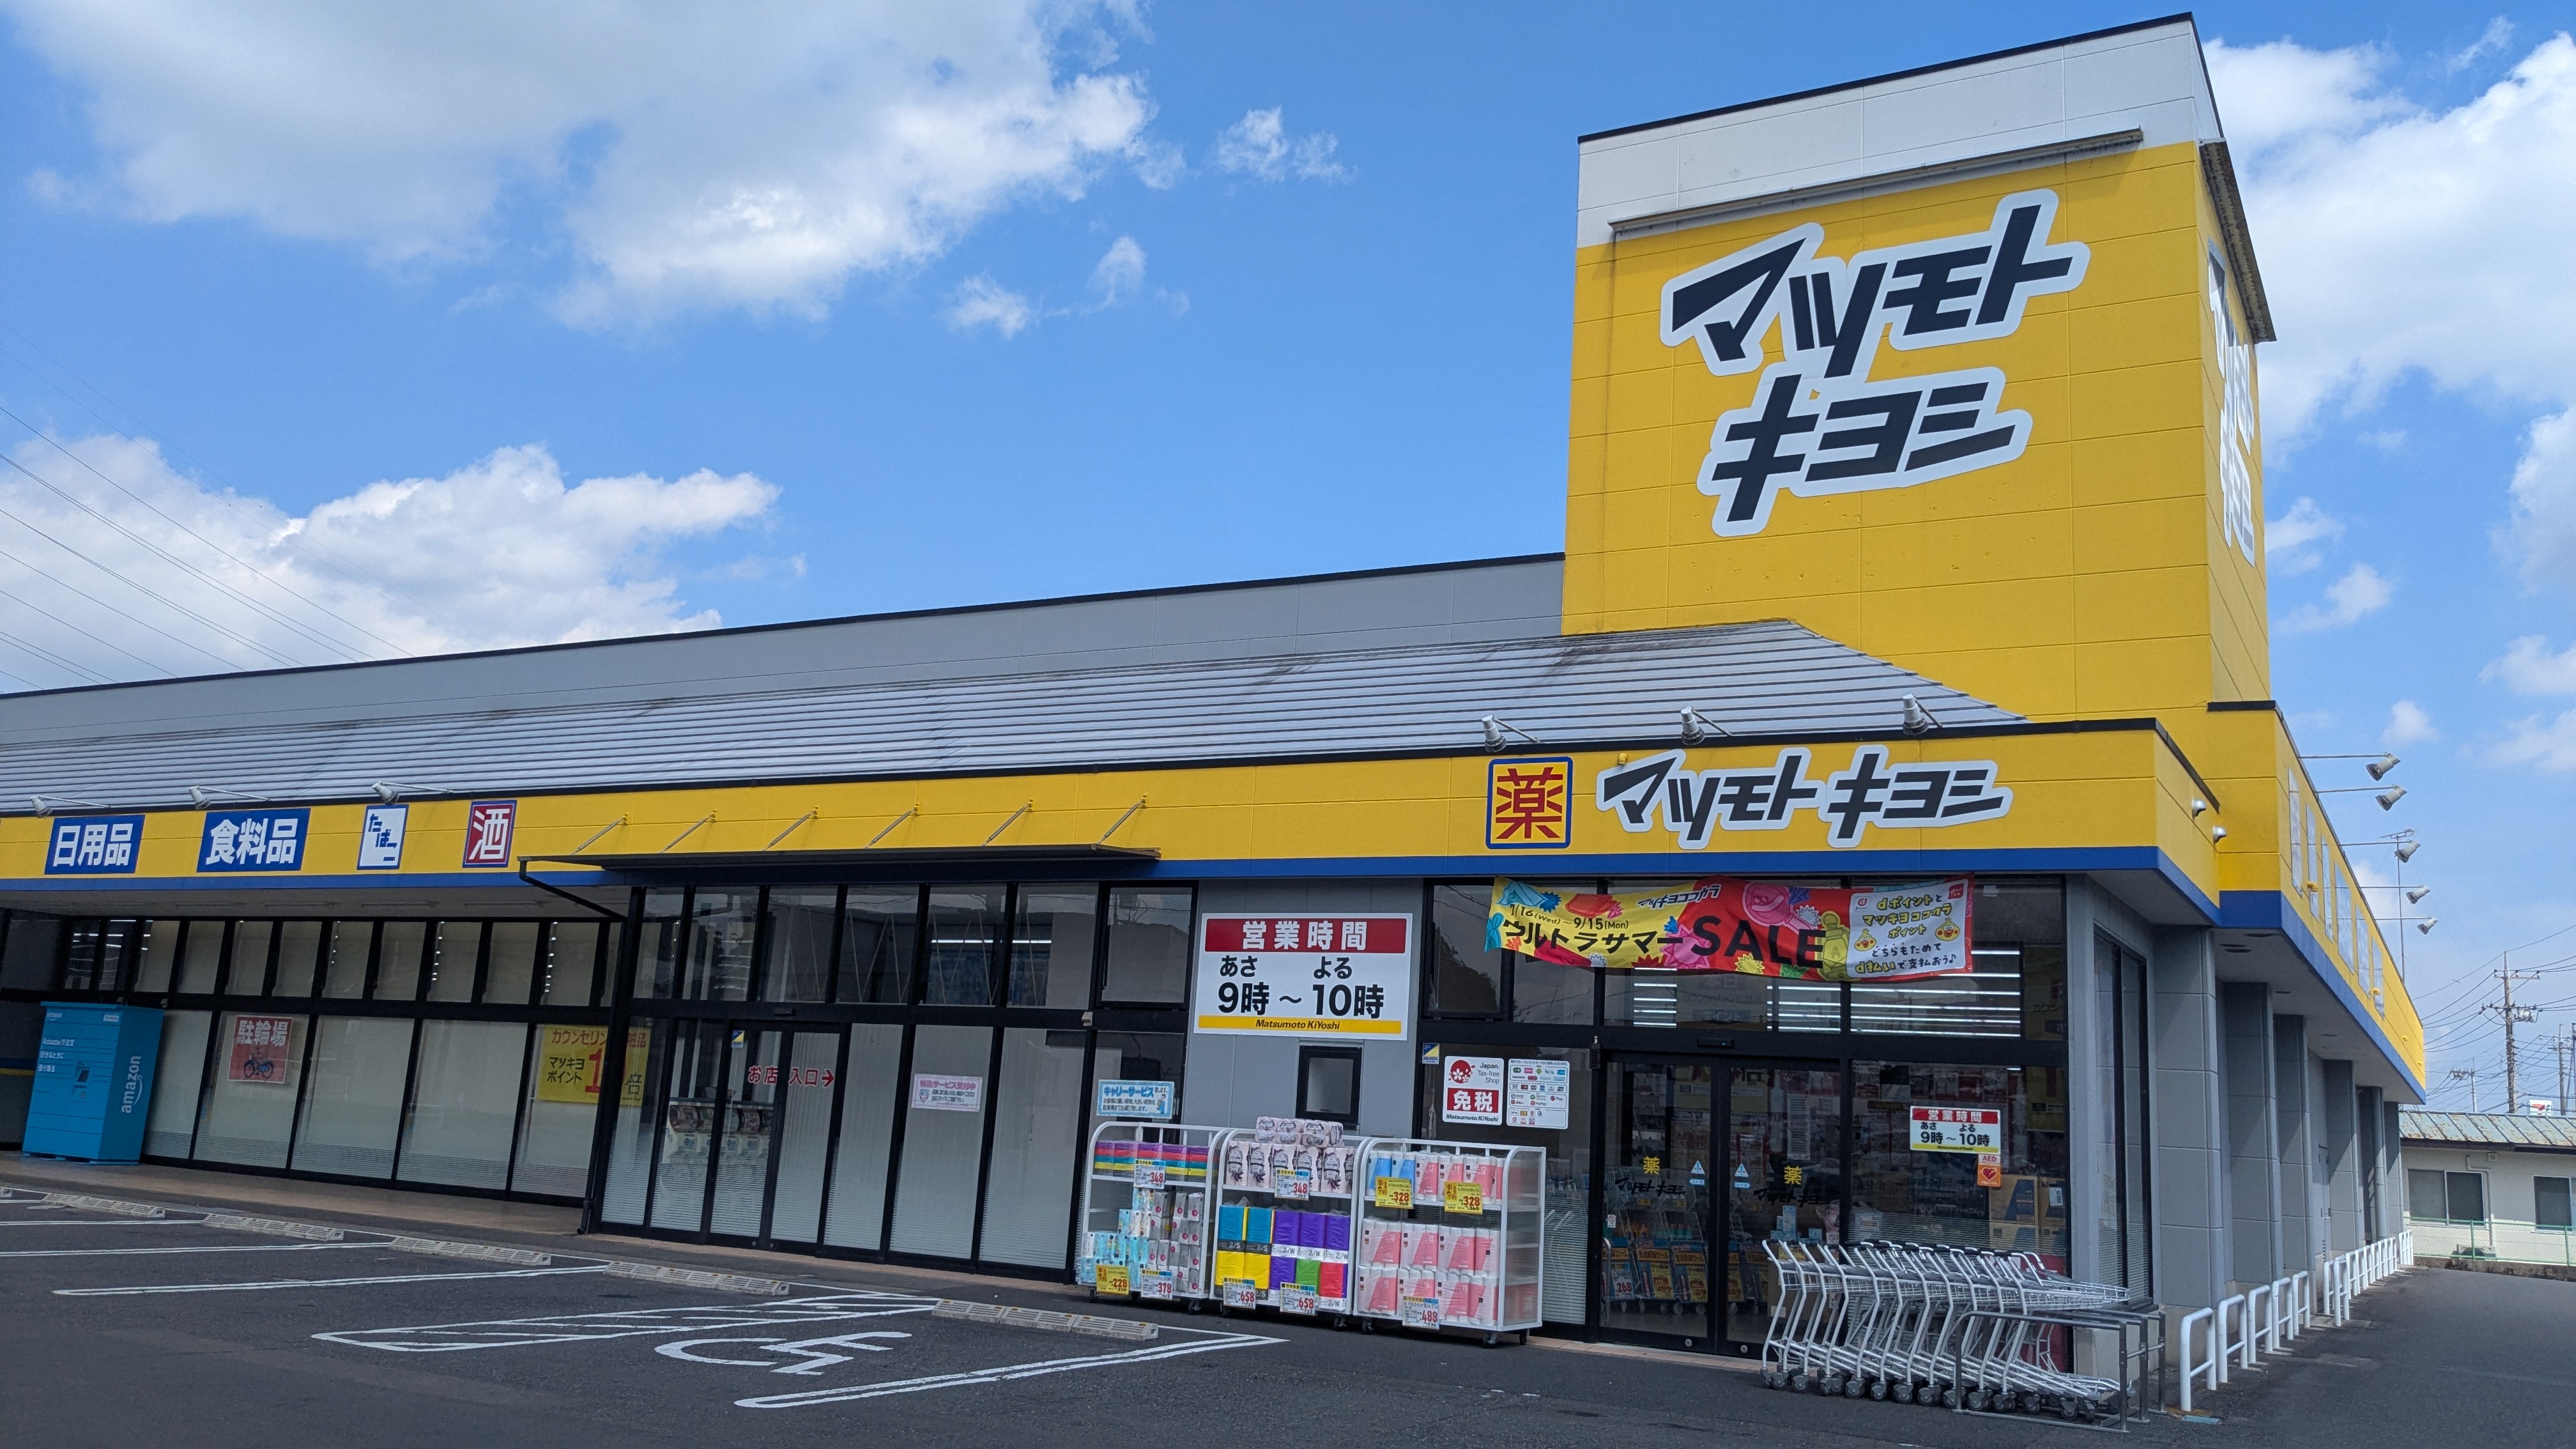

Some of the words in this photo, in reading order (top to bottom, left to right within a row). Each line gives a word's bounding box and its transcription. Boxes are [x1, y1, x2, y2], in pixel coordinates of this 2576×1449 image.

[1669, 201, 2076, 380] マツモト
[1708, 371, 2019, 524] キヨシ
[1494, 767, 1563, 839] 薬
[205, 817, 299, 866] 食料品
[468, 808, 511, 860] 酒
[53, 823, 134, 868] 日用品
[1862, 902, 1952, 926] マツキヨココカラ
[1242, 921, 1367, 951] 営業時間
[1887, 924, 1927, 939] ポイント
[1690, 915, 1827, 969] SALE
[1871, 942, 1942, 958] どちらもためて
[1220, 955, 1258, 977] あさ
[1313, 956, 1353, 979] よる
[1255, 1019, 1307, 1029] Matsumoto
[1307, 1020, 1341, 1030] KiYoshi
[236, 1020, 288, 1047] 駐輪場
[549, 1057, 585, 1070] マツキヨ
[121, 1055, 142, 1114] amazon
[546, 1070, 583, 1084] ポイント
[1103, 1085, 1154, 1098] キャリーサービス
[1453, 1090, 1493, 1112] 免税
[1928, 1109, 1982, 1123] 営業時間
[1920, 1121, 1937, 1130] あさ
[1959, 1124, 1976, 1132] よる
[1643, 1156, 1660, 1174] 薬
[1150, 1172, 1163, 1183] 348
[1784, 1165, 1802, 1185] 薬
[1292, 1182, 1308, 1194] 348
[1393, 1191, 1409, 1202] 328
[1463, 1195, 1480, 1207] 328
[1112, 1278, 1128, 1288] 228
[1158, 1282, 1172, 1294] 378
[1616, 1282, 1632, 1292] 268
[1240, 1291, 1255, 1303] 658
[1298, 1297, 1314, 1310] 658
[1422, 1309, 1438, 1322] 488
